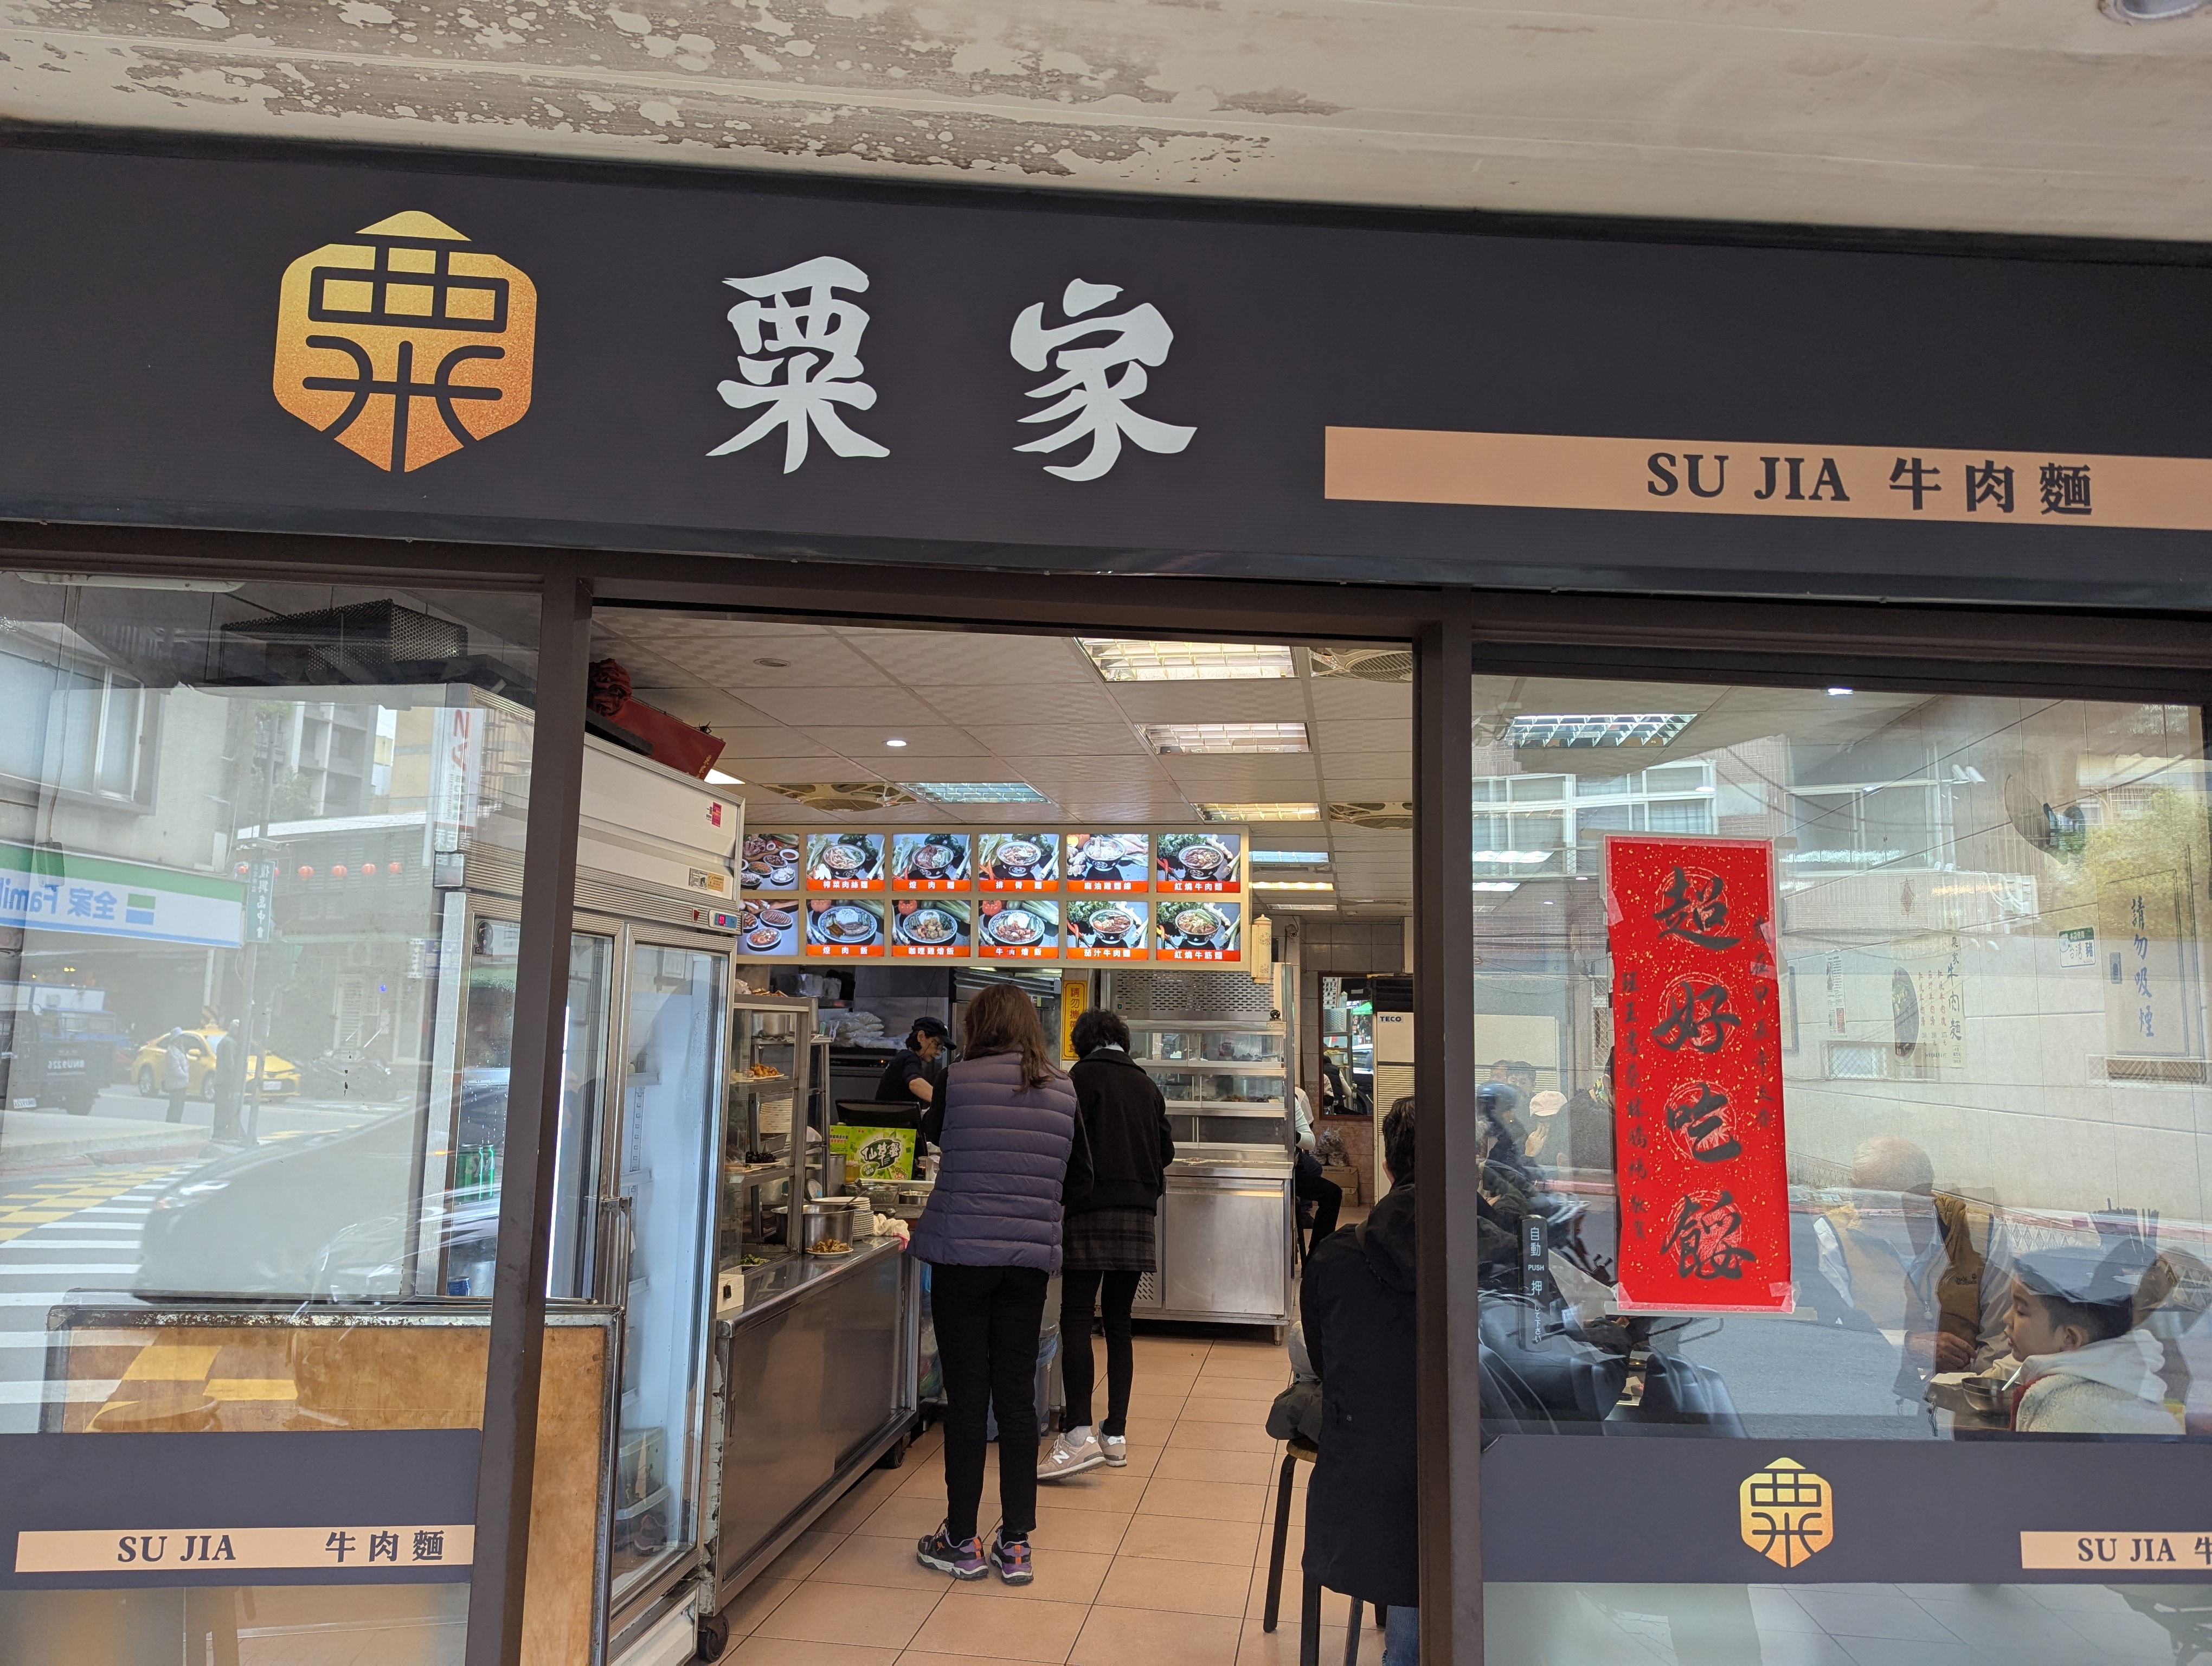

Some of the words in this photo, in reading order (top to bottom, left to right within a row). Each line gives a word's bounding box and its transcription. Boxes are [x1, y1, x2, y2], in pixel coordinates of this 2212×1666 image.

[1648, 453, 1729, 498] SU
[1754, 457, 1850, 502] JIA
[1889, 458, 2093, 516] 牛肉麵
[823, 880, 869, 889] 榨菜肉絲麵
[995, 881, 1043, 890] 排骨麵
[1084, 882, 1132, 890] 麻油雞麵線
[1174, 882, 1223, 891] 紅燒牛肉麵
[908, 947, 954, 956] 咖哩雞燴飯
[1084, 949, 1131, 957] 茄汁牛肉麵
[1174, 951, 1223, 960] 紅燒牛筋麵
[2131, 895, 2155, 1038] 請勿吸煙
[861, 1140, 900, 1167] 仙草蜜
[1529, 1226, 1541, 1257] 自動
[118, 1536, 168, 1563] SU
[180, 1535, 236, 1562] JIA
[325, 1530, 445, 1564] 牛肉麵
[2078, 1538, 2118, 1562] SU
[2130, 1538, 2177, 1562] JIA
